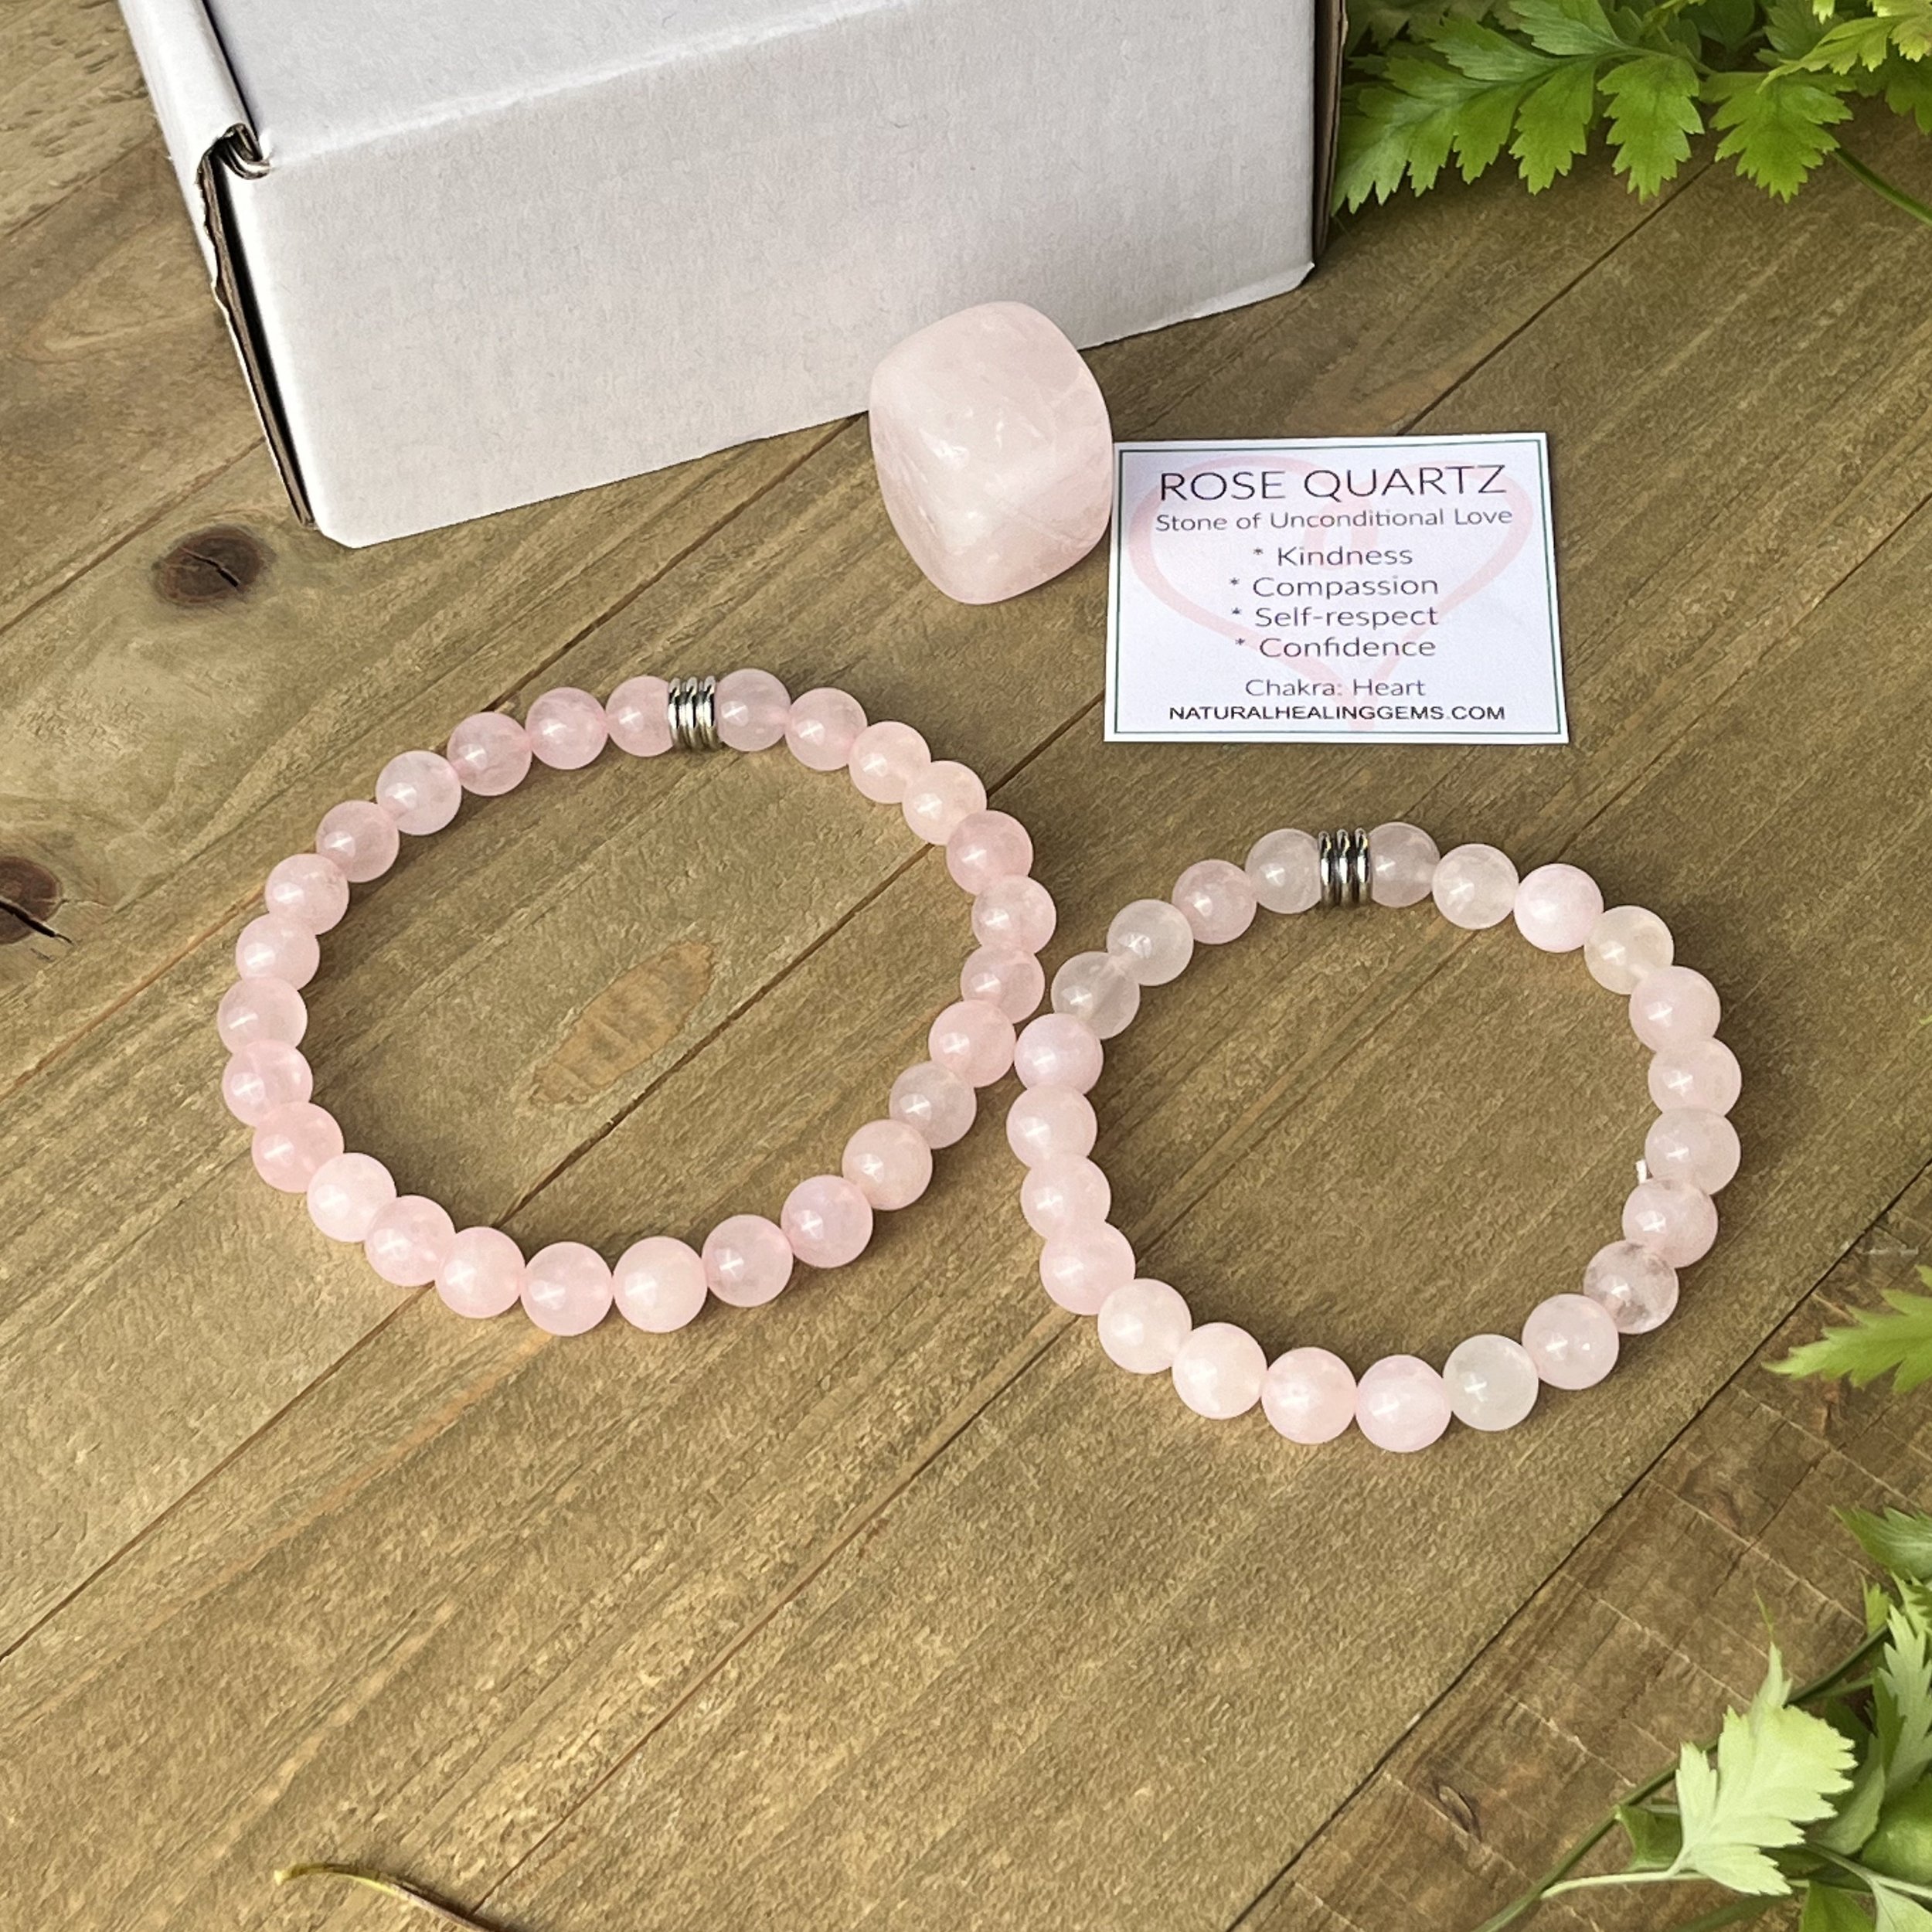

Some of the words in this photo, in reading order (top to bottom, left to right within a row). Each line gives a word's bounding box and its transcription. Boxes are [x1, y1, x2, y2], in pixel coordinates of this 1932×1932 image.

[1159, 468, 1286, 504] ROSE
[1304, 464, 1507, 502] QUARTZ
[1155, 512, 1227, 532] Stone
[1236, 512, 1261, 529] of
[1270, 508, 1444, 529] Unconditional
[1454, 509, 1512, 525] Love
[1278, 546, 1413, 566] Kindness
[1253, 575, 1438, 600] Compassion
[1255, 607, 1439, 631] Self-respect
[1260, 637, 1436, 658] Confidence
[1245, 679, 1342, 696] Chakra:
[1353, 679, 1426, 696] Heart
[1169, 706, 1505, 720] NATURALHEALINGGEMS.COM
